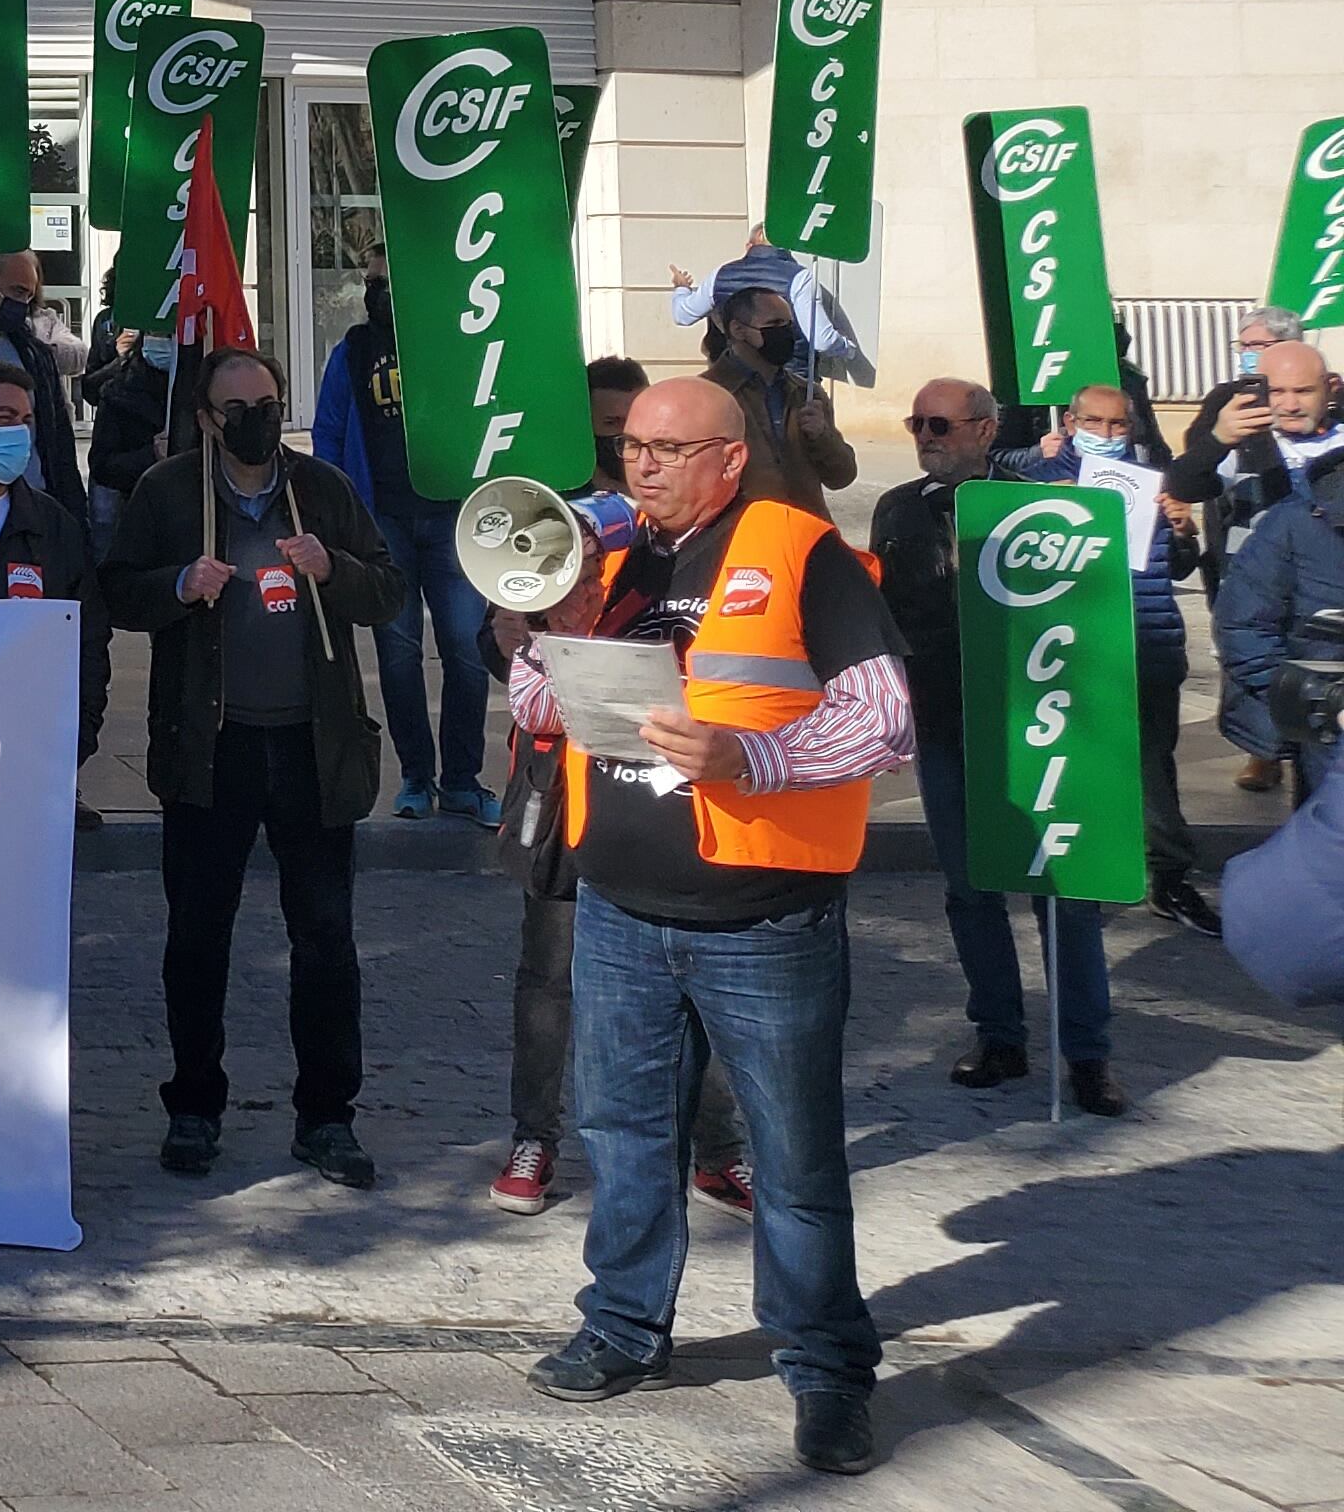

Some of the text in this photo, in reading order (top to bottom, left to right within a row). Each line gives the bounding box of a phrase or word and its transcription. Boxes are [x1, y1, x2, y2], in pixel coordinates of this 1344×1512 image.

[800, 58, 845, 241] CSIF
[455, 192, 524, 479] CSIF
[1021, 210, 1070, 393] CSIF
[267, 598, 297, 613] CGT
[1026, 625, 1080, 877] CSIF
